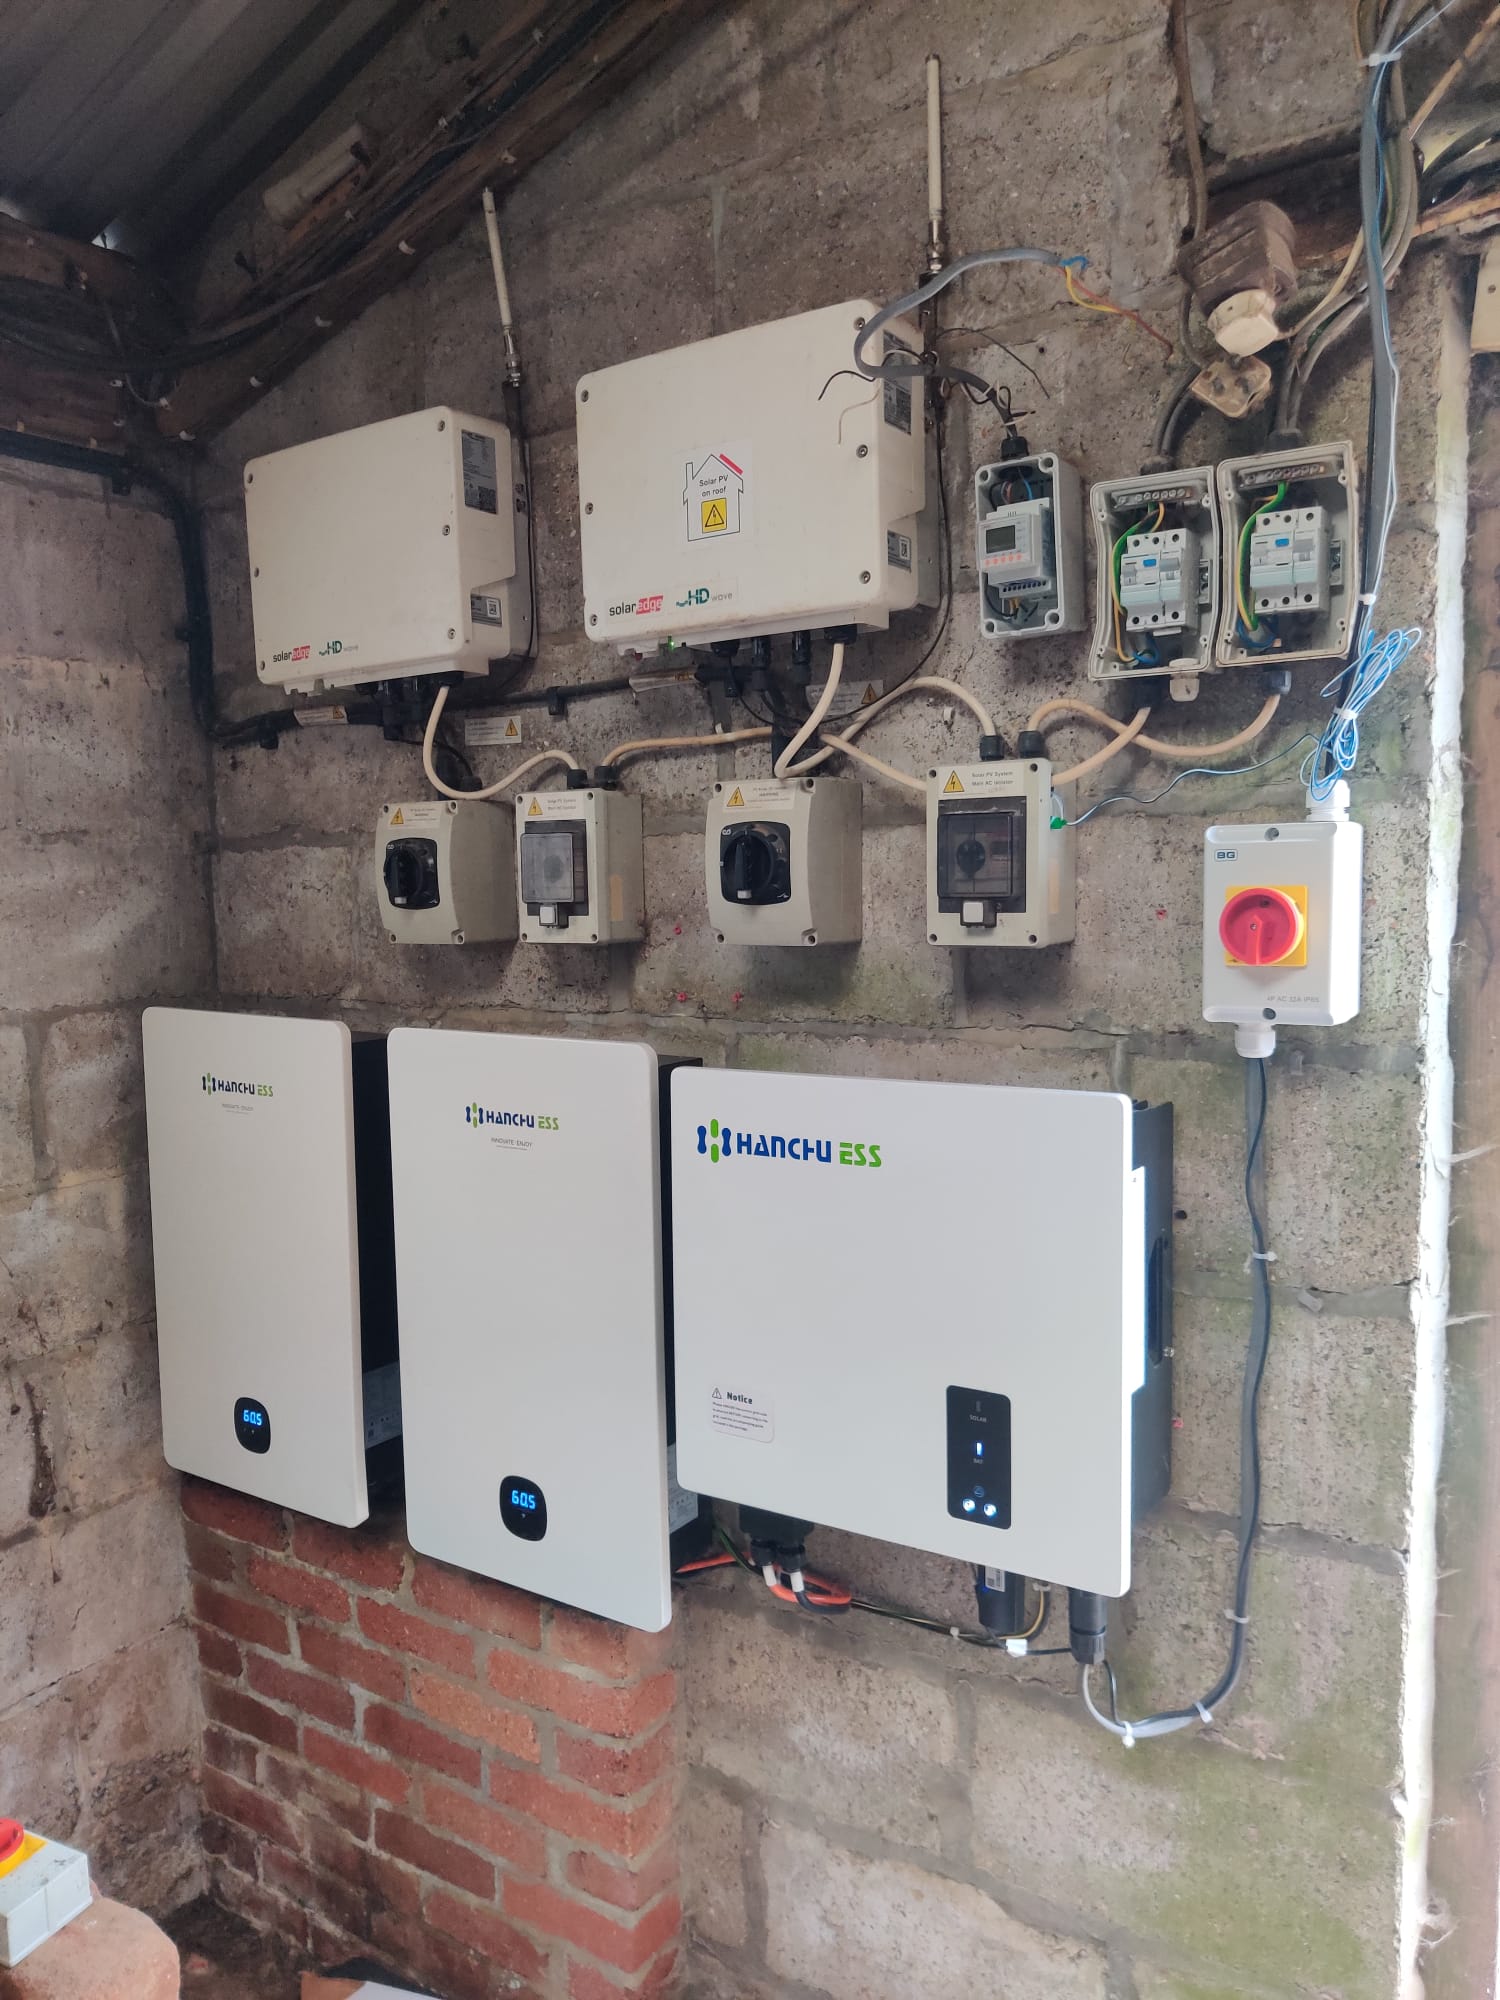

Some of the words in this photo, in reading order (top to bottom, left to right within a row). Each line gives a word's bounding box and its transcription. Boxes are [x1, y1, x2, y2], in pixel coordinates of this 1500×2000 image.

[699, 478, 717, 487] Solar
[718, 474, 729, 483] PV
[701, 489, 711, 497] on
[713, 486, 727, 496] roof
[609, 595, 663, 616] solaredge
[688, 587, 710, 606] HD
[711, 592, 733, 602] wave
[273, 645, 310, 662] solaredge
[327, 640, 343, 655] HD
[1217, 851, 1236, 859] BG
[218, 1079, 256, 1095] HANCHU
[257, 1084, 274, 1097] ESS
[486, 1110, 535, 1128] HANCHU
[537, 1115, 560, 1131] ESS
[736, 1132, 832, 1164] HANCHU
[839, 1142, 882, 1168] ESS
[726, 1391, 753, 1404] Notice
